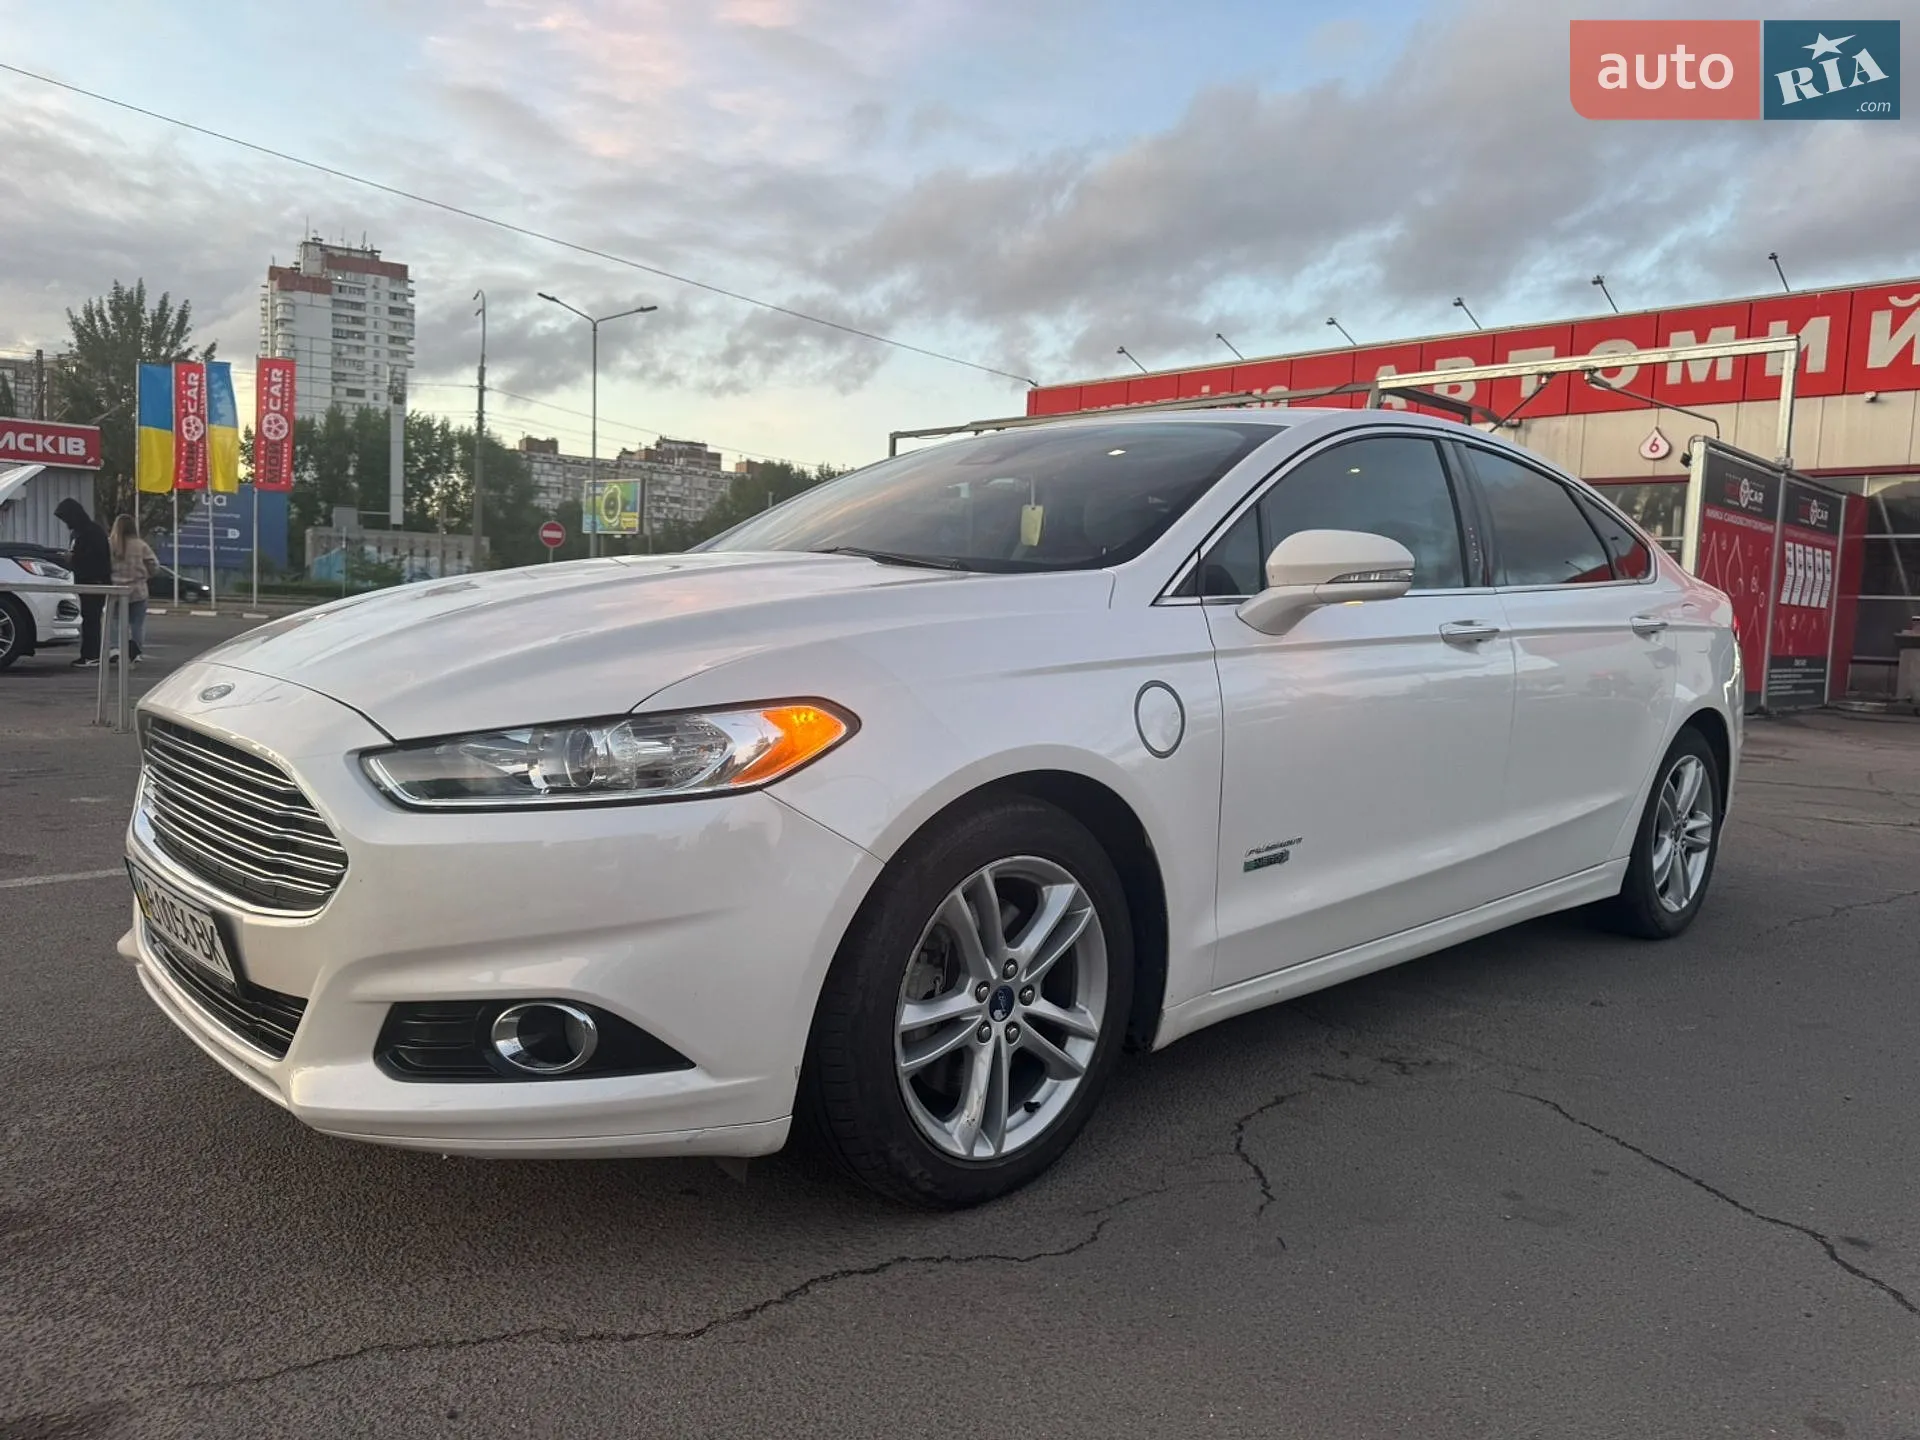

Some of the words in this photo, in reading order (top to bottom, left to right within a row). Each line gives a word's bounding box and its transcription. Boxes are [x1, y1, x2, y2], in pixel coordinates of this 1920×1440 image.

[187, 373, 199, 413] CAR
[269, 368, 284, 411] CAR
[1649, 437, 1660, 452] 6
[1748, 488, 1764, 503] CAR
[188, 913, 231, 973] BK
